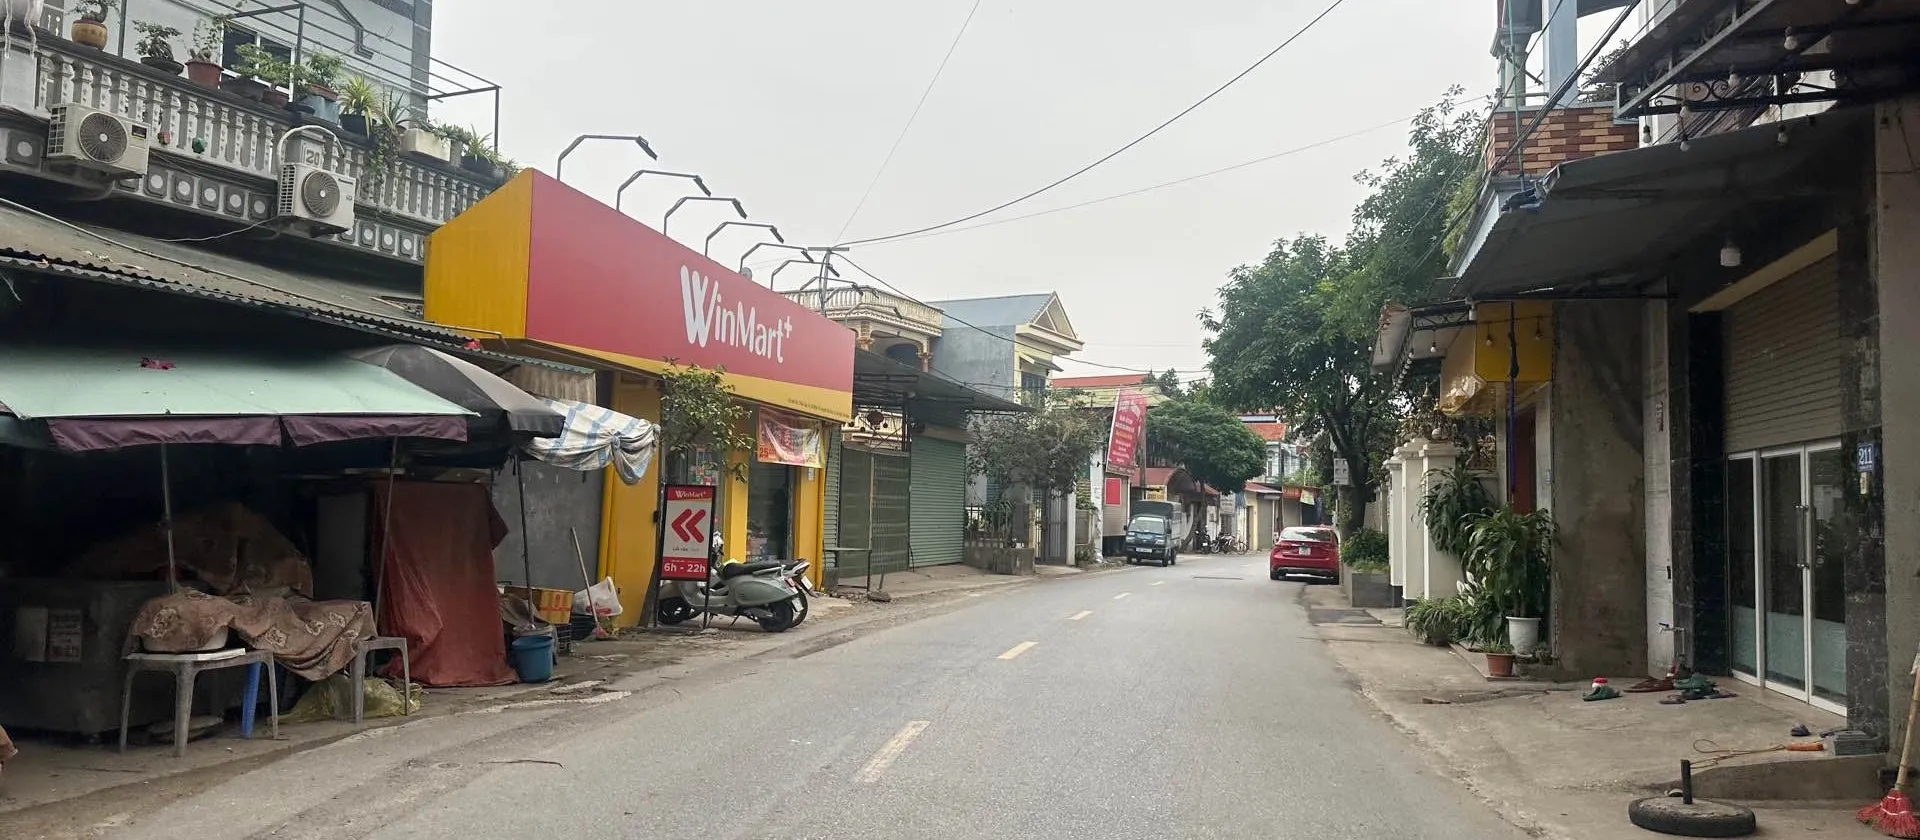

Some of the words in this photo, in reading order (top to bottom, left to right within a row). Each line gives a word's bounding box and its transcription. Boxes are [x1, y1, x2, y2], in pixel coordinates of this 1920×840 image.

[306, 150, 320, 166] 20
[681, 264, 792, 364] WinMart+
[1858, 447, 1873, 465] 211
[664, 563, 676, 572] 6h
[686, 563, 706, 573] 22h
